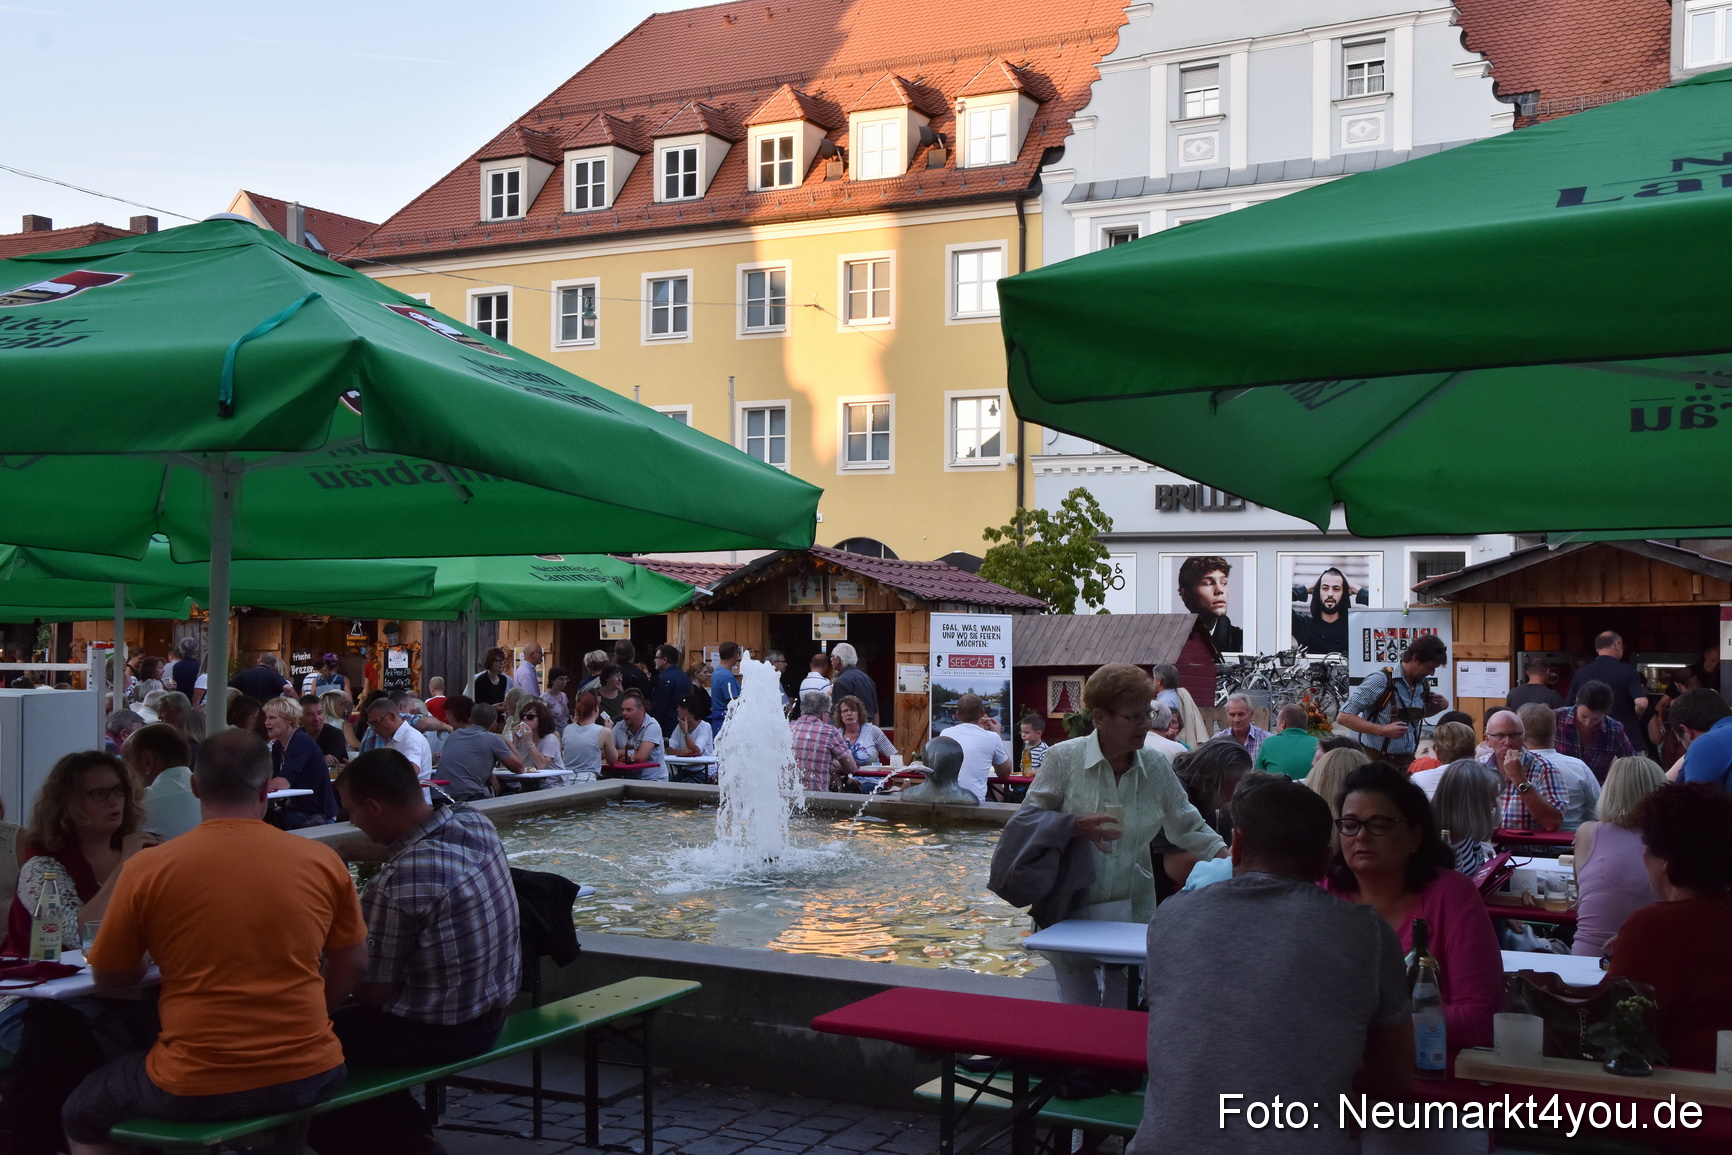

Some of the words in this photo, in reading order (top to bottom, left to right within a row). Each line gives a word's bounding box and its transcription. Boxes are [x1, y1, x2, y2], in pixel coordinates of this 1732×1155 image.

[1555, 173, 1732, 208] La
[1154, 483, 1250, 512] BRILLE
[942, 623, 960, 632] EGAL,
[961, 624, 979, 633] WAS,
[980, 624, 1001, 633] WANN
[942, 631, 956, 639] UND
[956, 631, 968, 640] WO
[969, 632, 978, 640] SIE
[980, 632, 1001, 641] FEIERN
